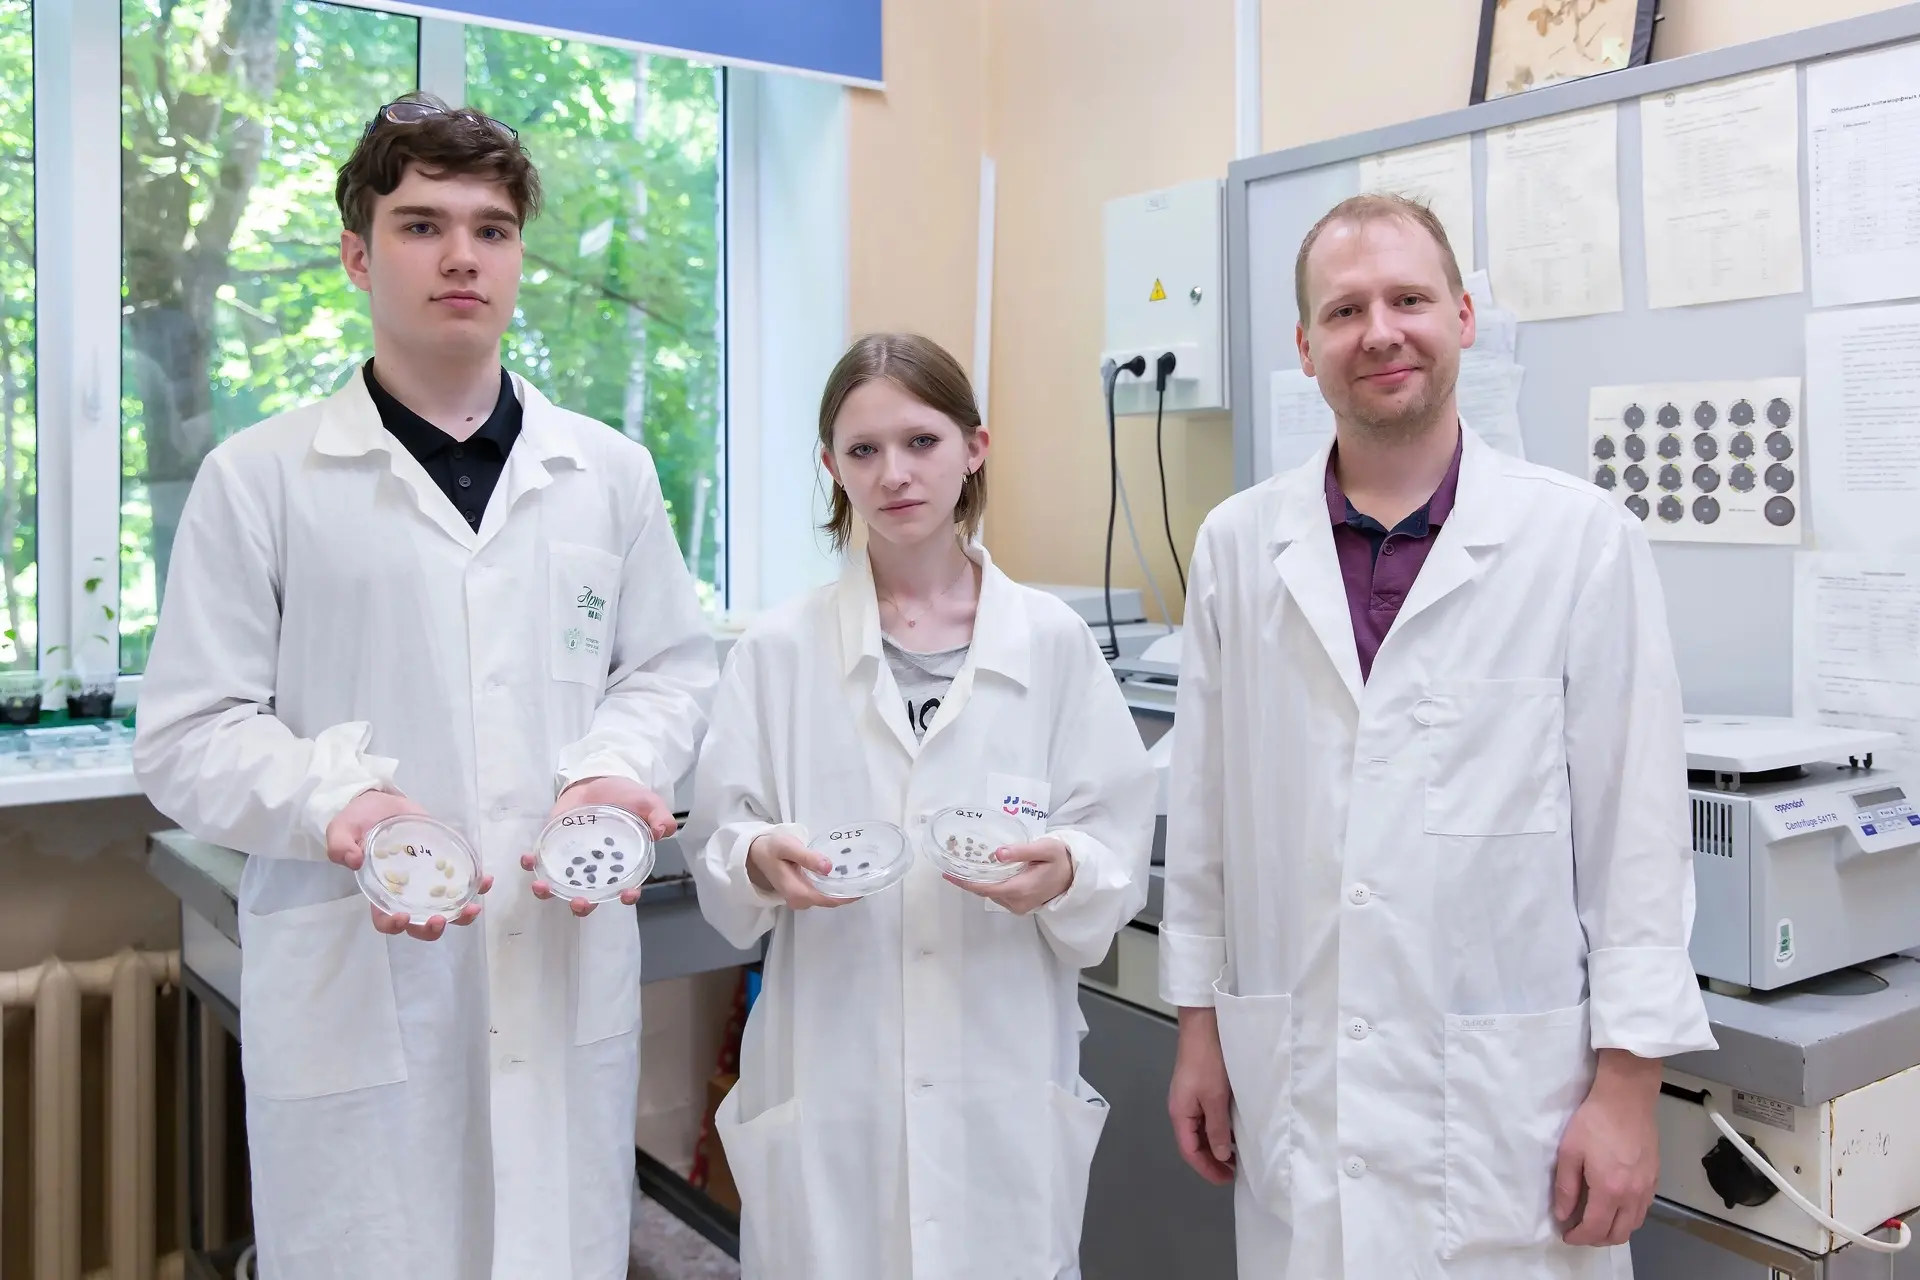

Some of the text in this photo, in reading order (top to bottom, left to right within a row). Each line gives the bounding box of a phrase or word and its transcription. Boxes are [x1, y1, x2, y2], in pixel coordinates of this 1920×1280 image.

[1775, 798, 1805, 813] eppendorf
[562, 815, 597, 826] QI7
[1785, 819, 1818, 830] Centrifuge
[830, 829, 864, 840] QI5
